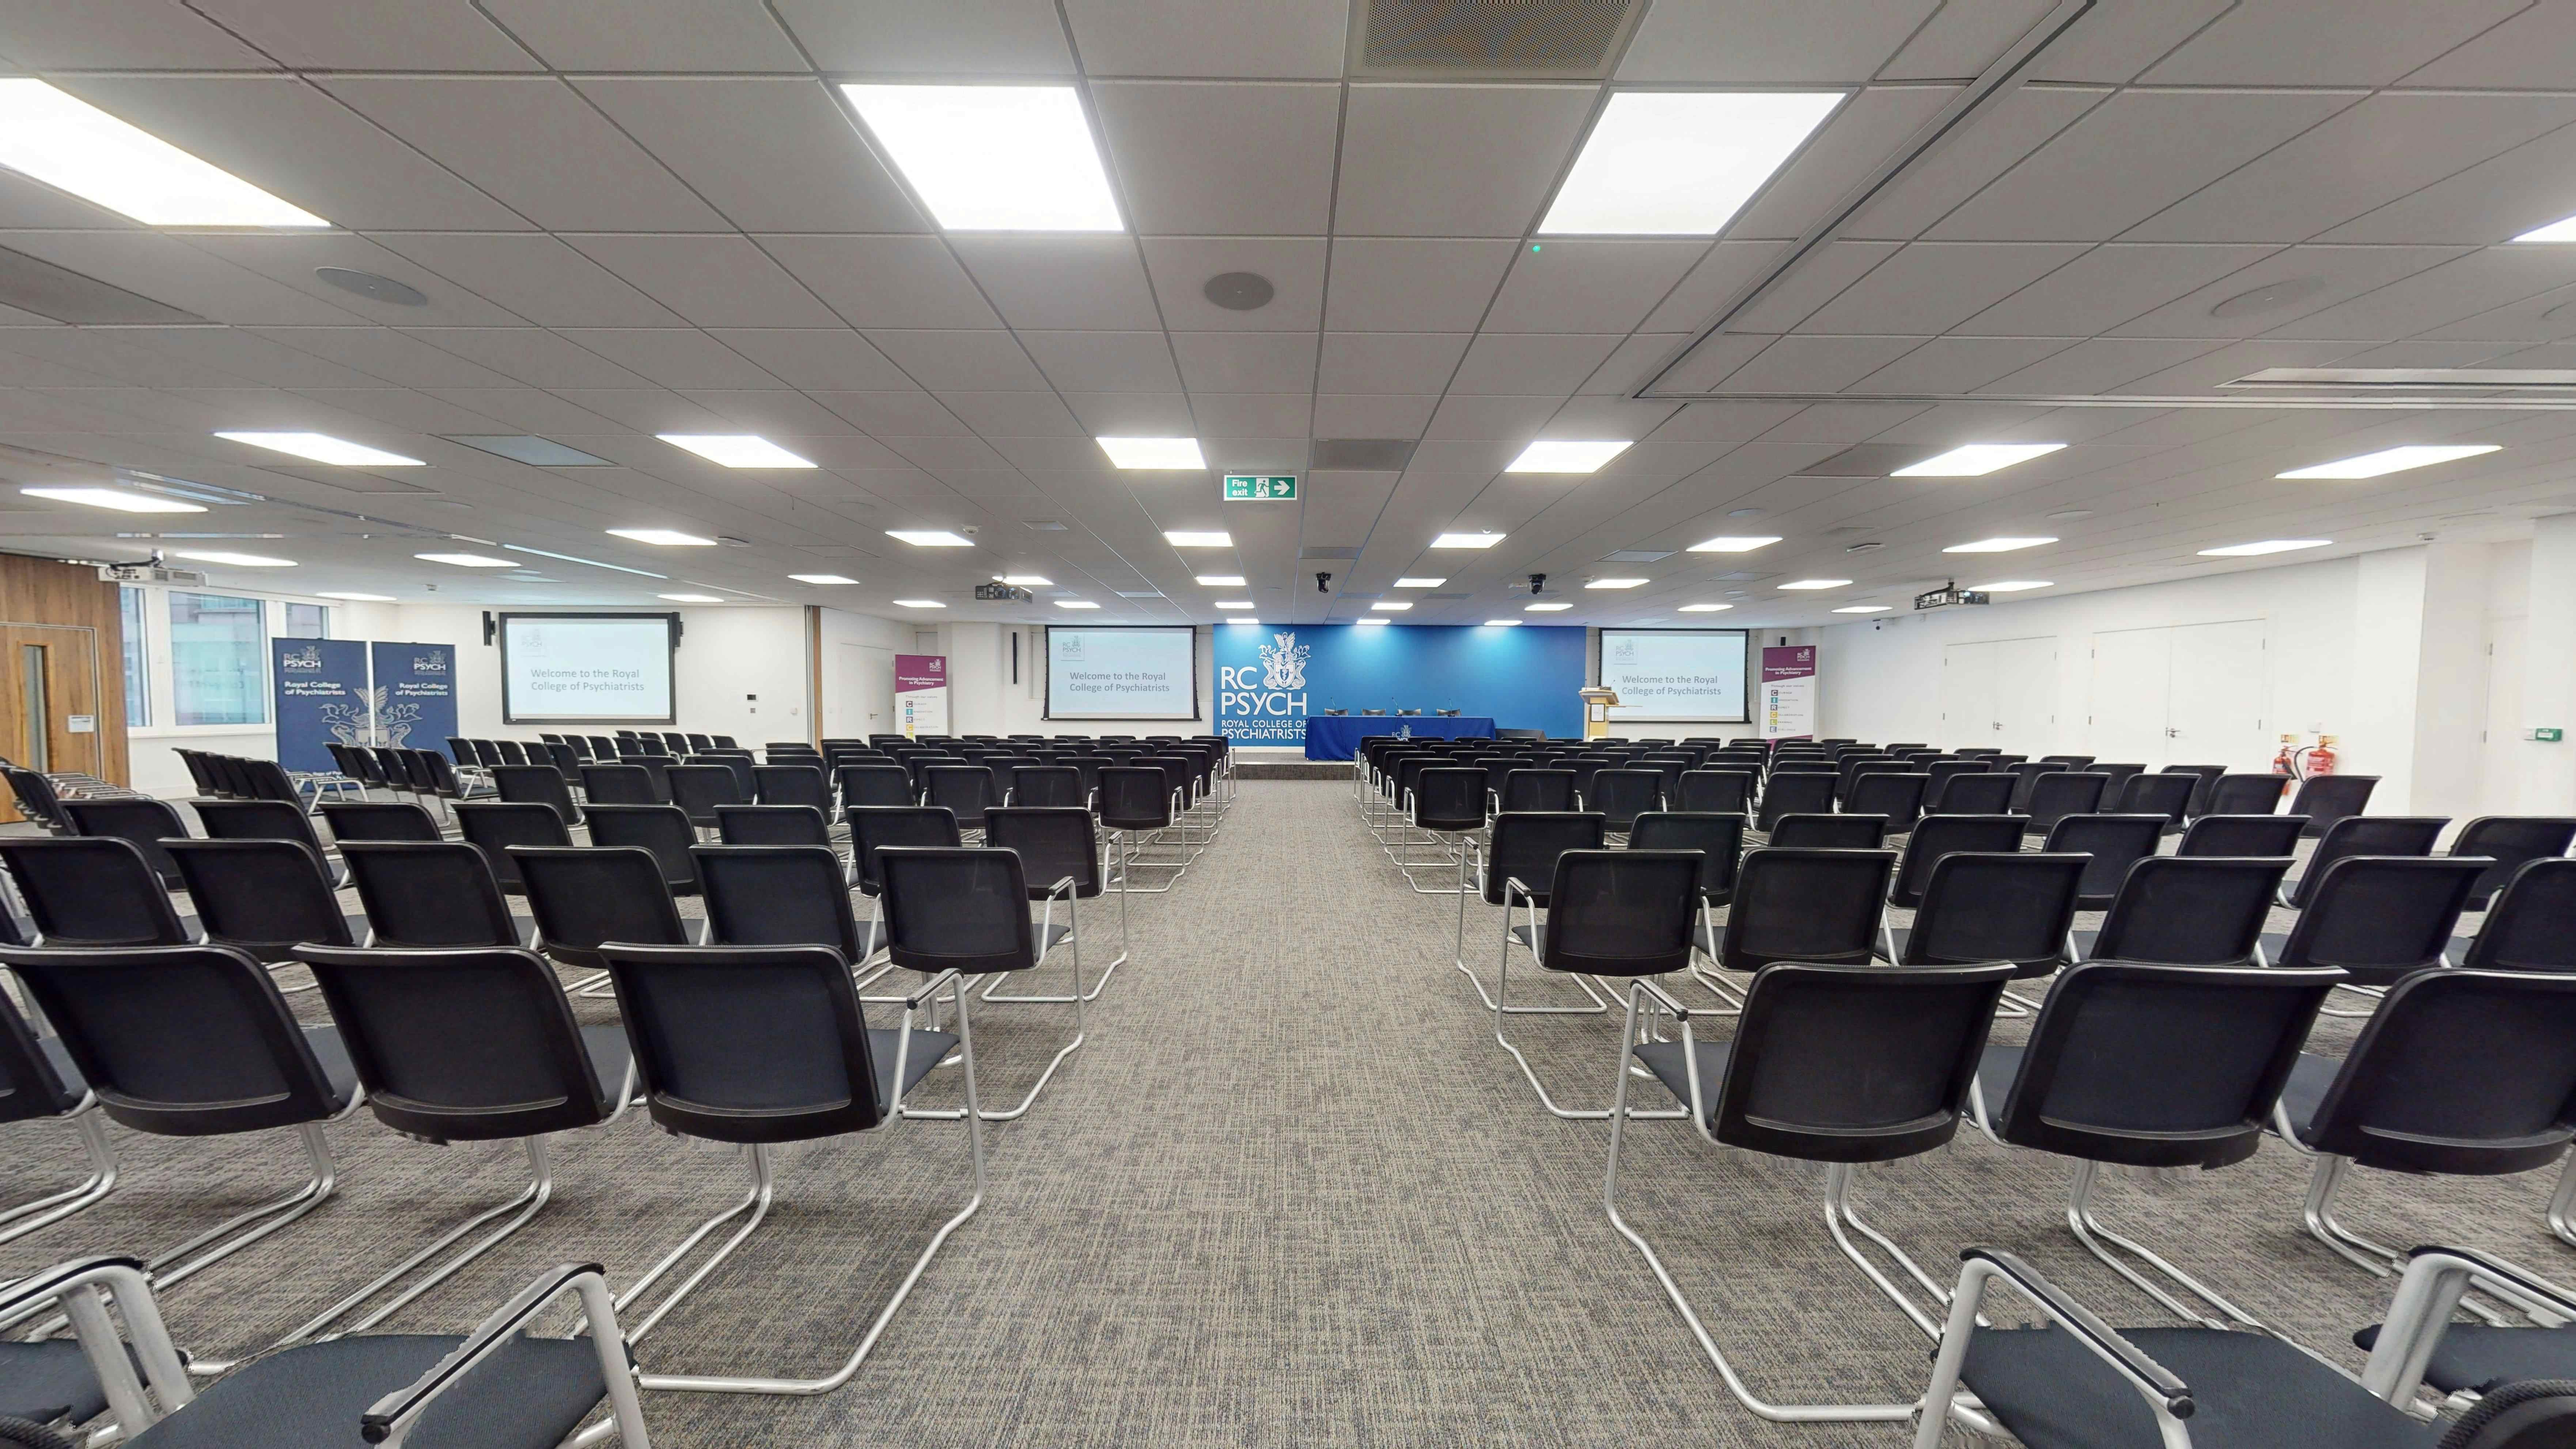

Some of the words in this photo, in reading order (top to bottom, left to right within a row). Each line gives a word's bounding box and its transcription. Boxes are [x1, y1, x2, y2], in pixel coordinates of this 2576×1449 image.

[531, 669, 576, 678] Welcome
[593, 669, 609, 678] the
[613, 669, 639, 679] Royal
[1143, 672, 1166, 682] Royal
[1221, 666, 1257, 690] RC
[1694, 676, 1717, 685] Royal
[532, 682, 567, 692] College
[570, 682, 580, 690] of
[583, 682, 644, 692] Psychiatrists
[1070, 684, 1102, 693] College
[1116, 684, 1170, 693] Psychiatrists
[1622, 687, 1653, 696] College
[1668, 687, 1721, 696] Psychiatrists
[1221, 692, 1307, 716] PSYCH
[1222, 729, 1306, 739] PSYCHIATRISTS
